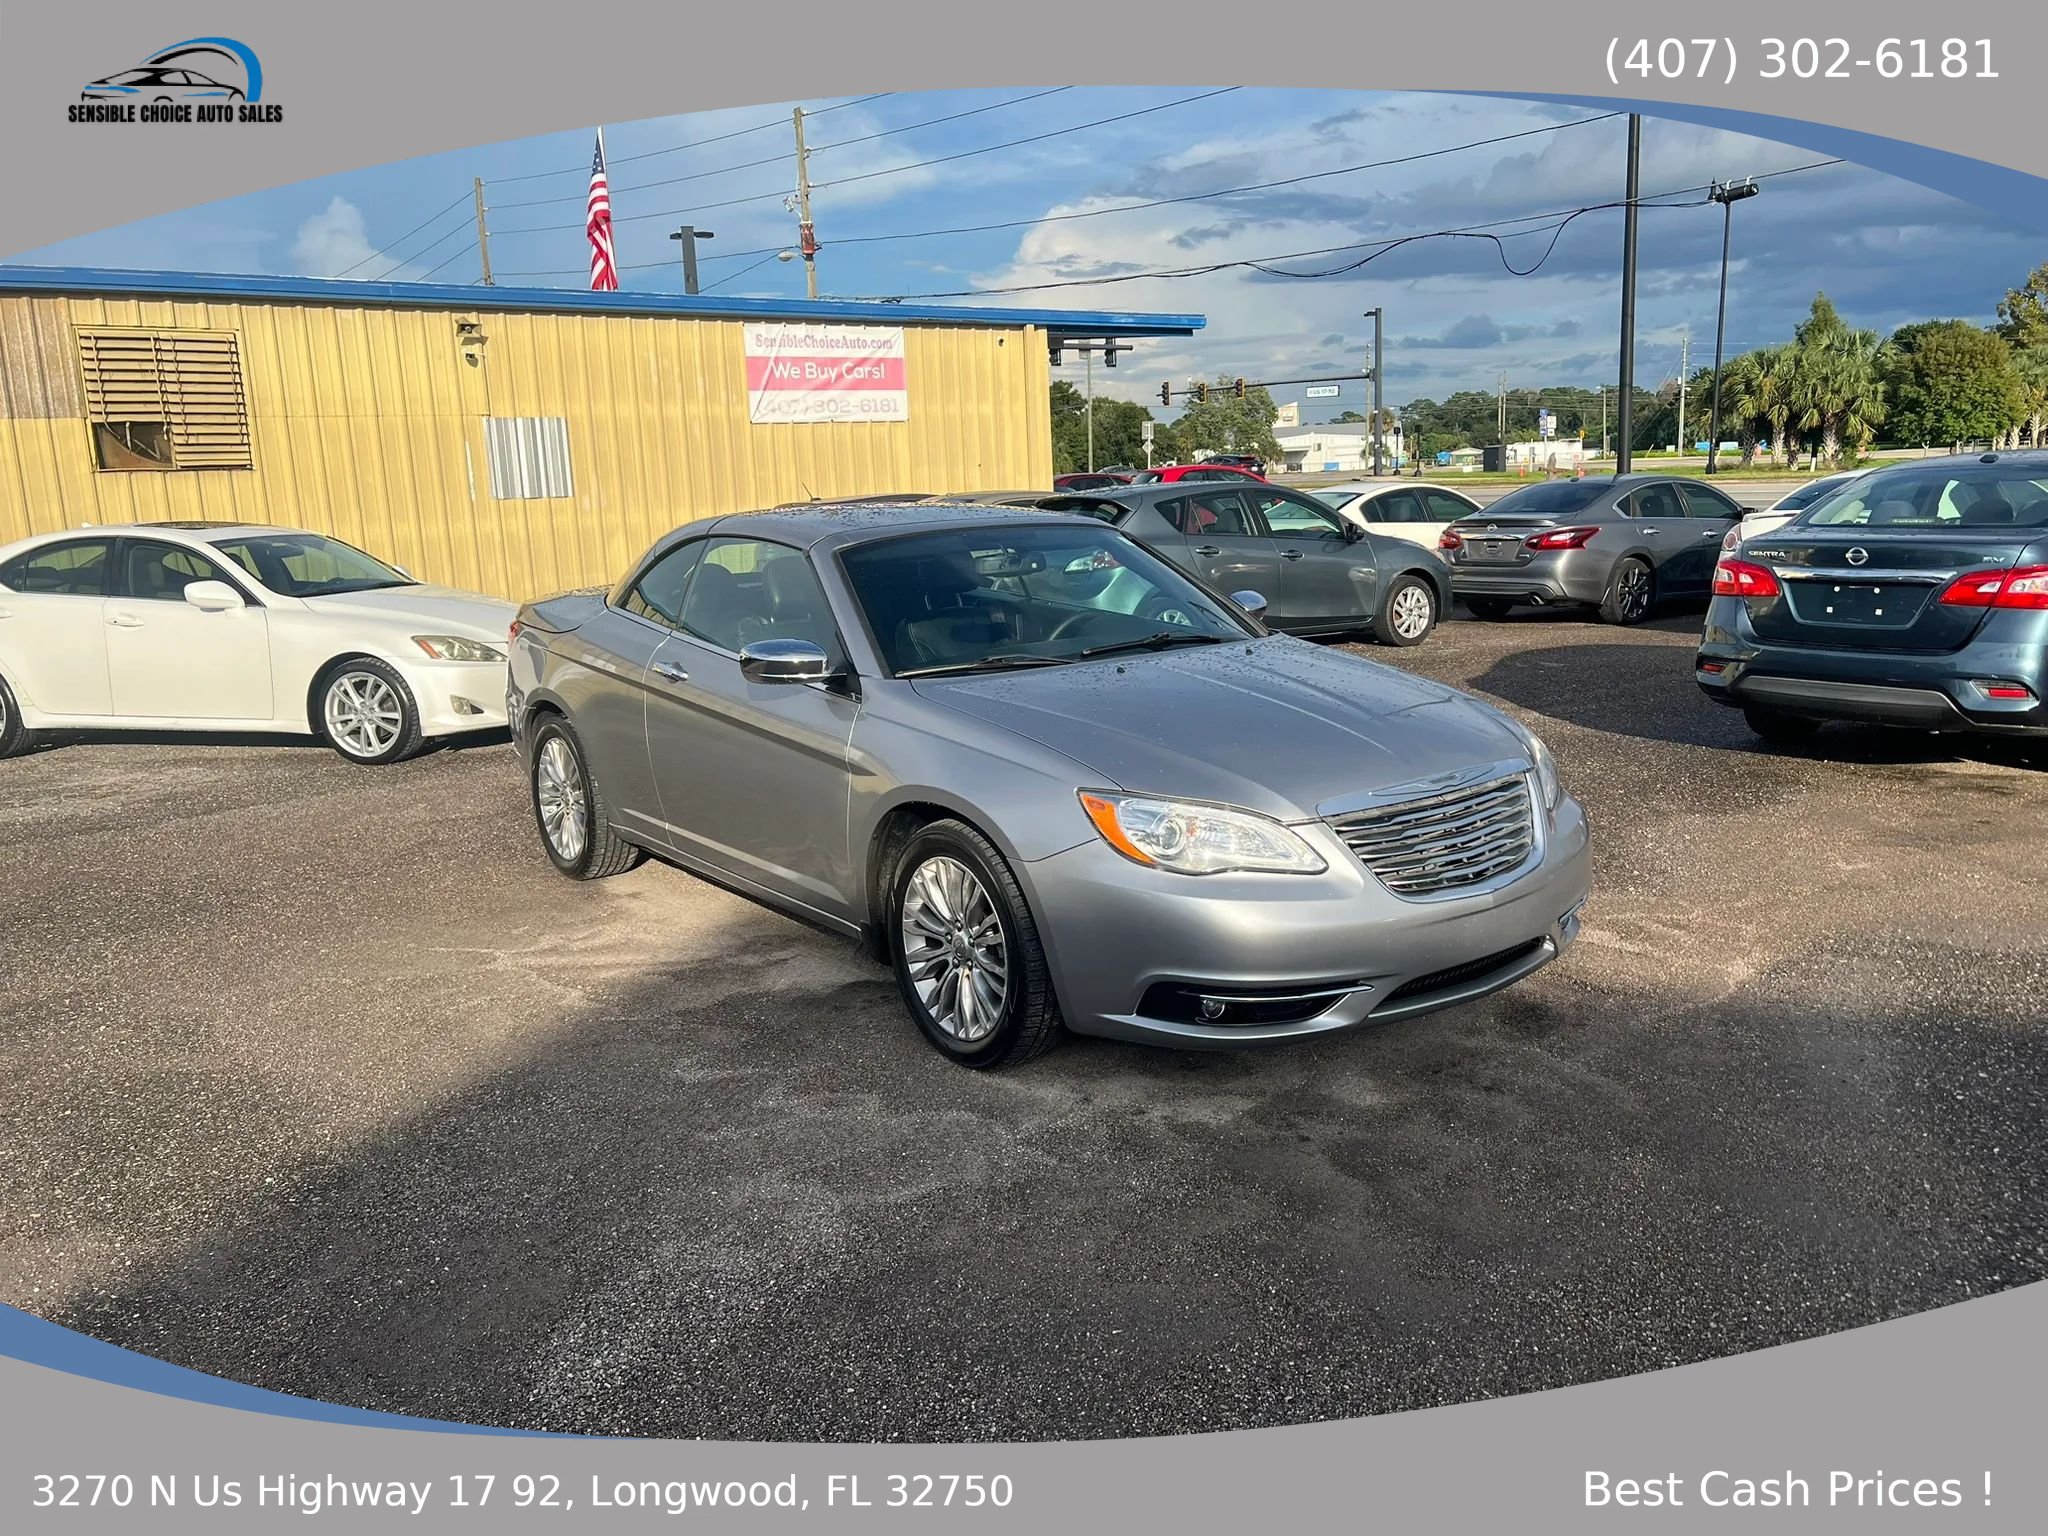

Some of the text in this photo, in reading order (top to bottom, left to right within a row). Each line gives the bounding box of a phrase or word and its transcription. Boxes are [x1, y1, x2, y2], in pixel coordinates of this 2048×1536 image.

[771, 361, 886, 383] We Buy Cars!
[814, 398, 899, 414] 302-6181
[1748, 550, 1786, 558] SENTRA
